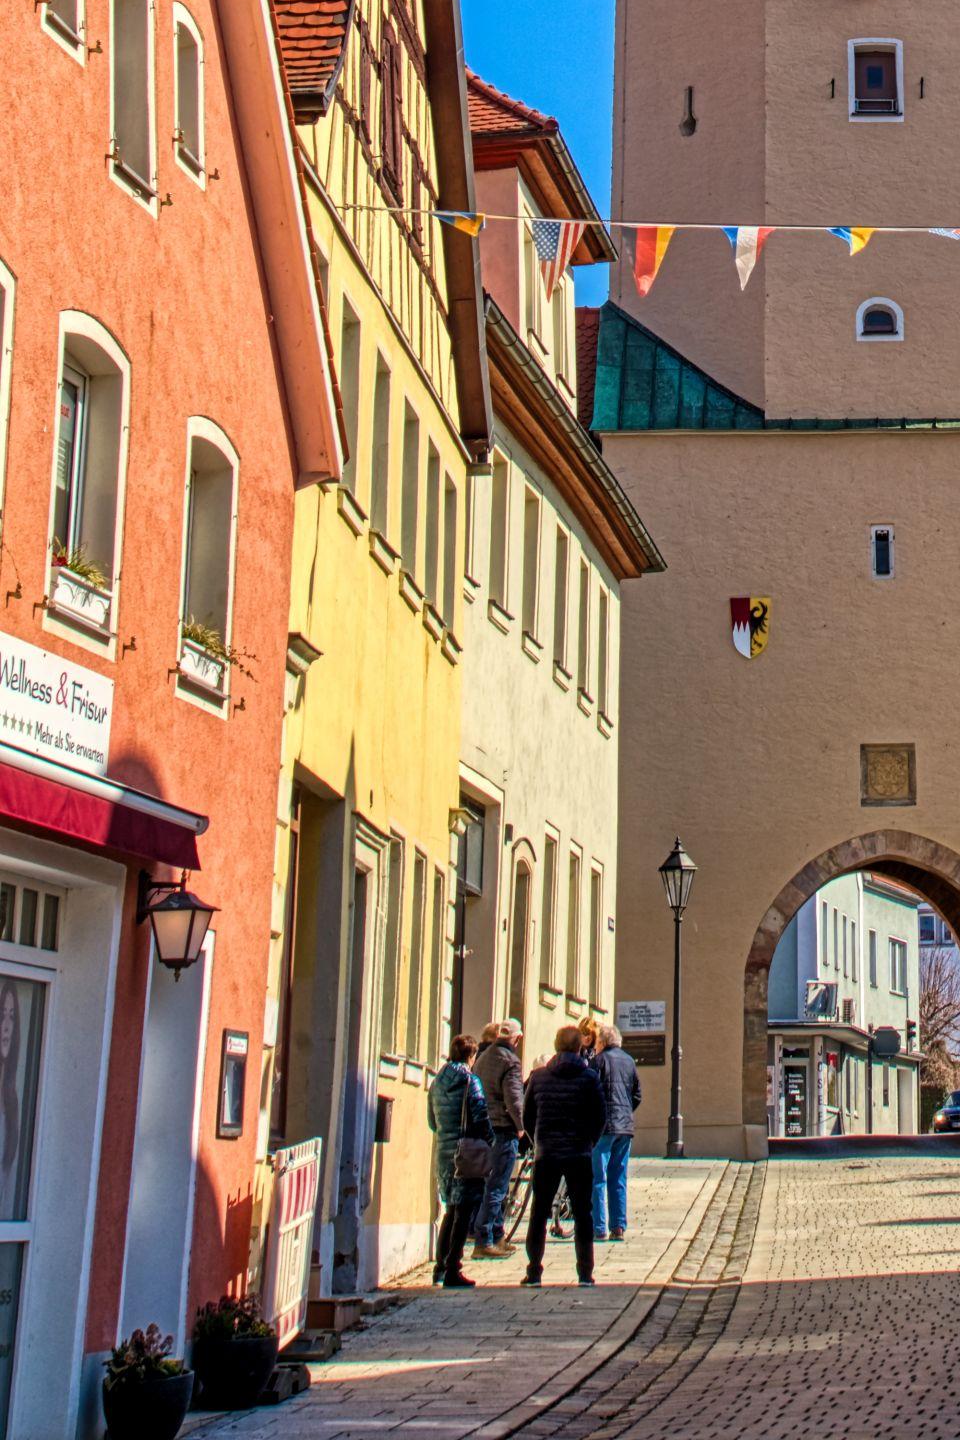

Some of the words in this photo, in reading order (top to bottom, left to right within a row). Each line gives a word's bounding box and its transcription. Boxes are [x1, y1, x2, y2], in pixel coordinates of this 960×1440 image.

[0, 652, 52, 704] Wellness
[56, 671, 68, 709] &
[71, 680, 107, 724] Frisur
[34, 721, 53, 745] Mehr
[54, 730, 64, 750] als
[65, 732, 75, 754] Sie
[76, 744, 104, 764] erwarten
